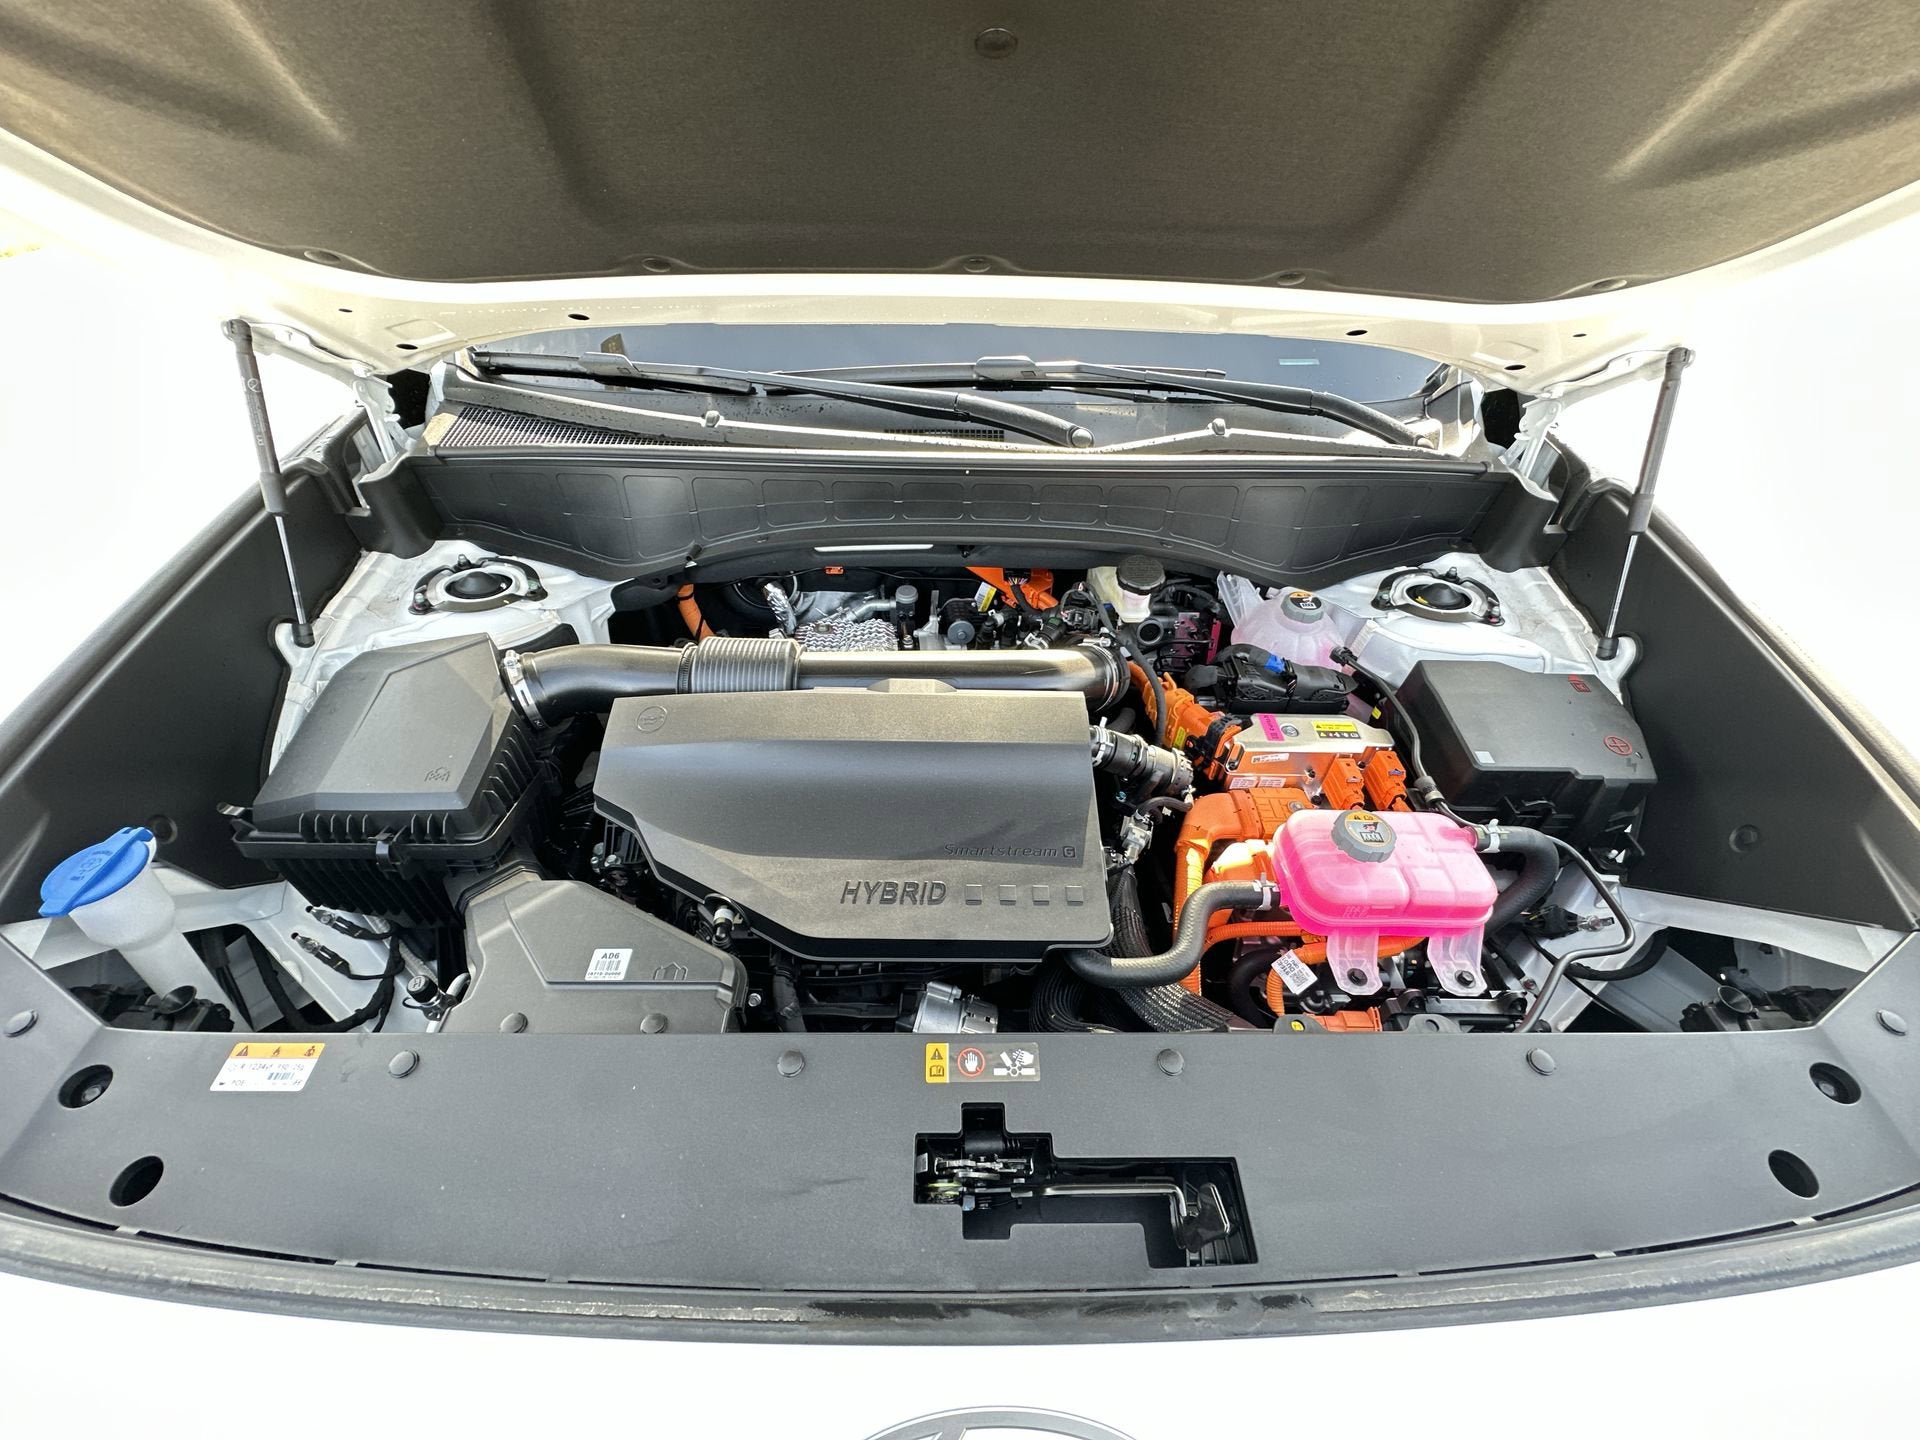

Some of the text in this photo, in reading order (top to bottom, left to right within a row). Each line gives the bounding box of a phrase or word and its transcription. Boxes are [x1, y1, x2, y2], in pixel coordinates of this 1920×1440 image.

[944, 843, 1076, 858] Smartstream G
[840, 880, 947, 906] HYBRID
